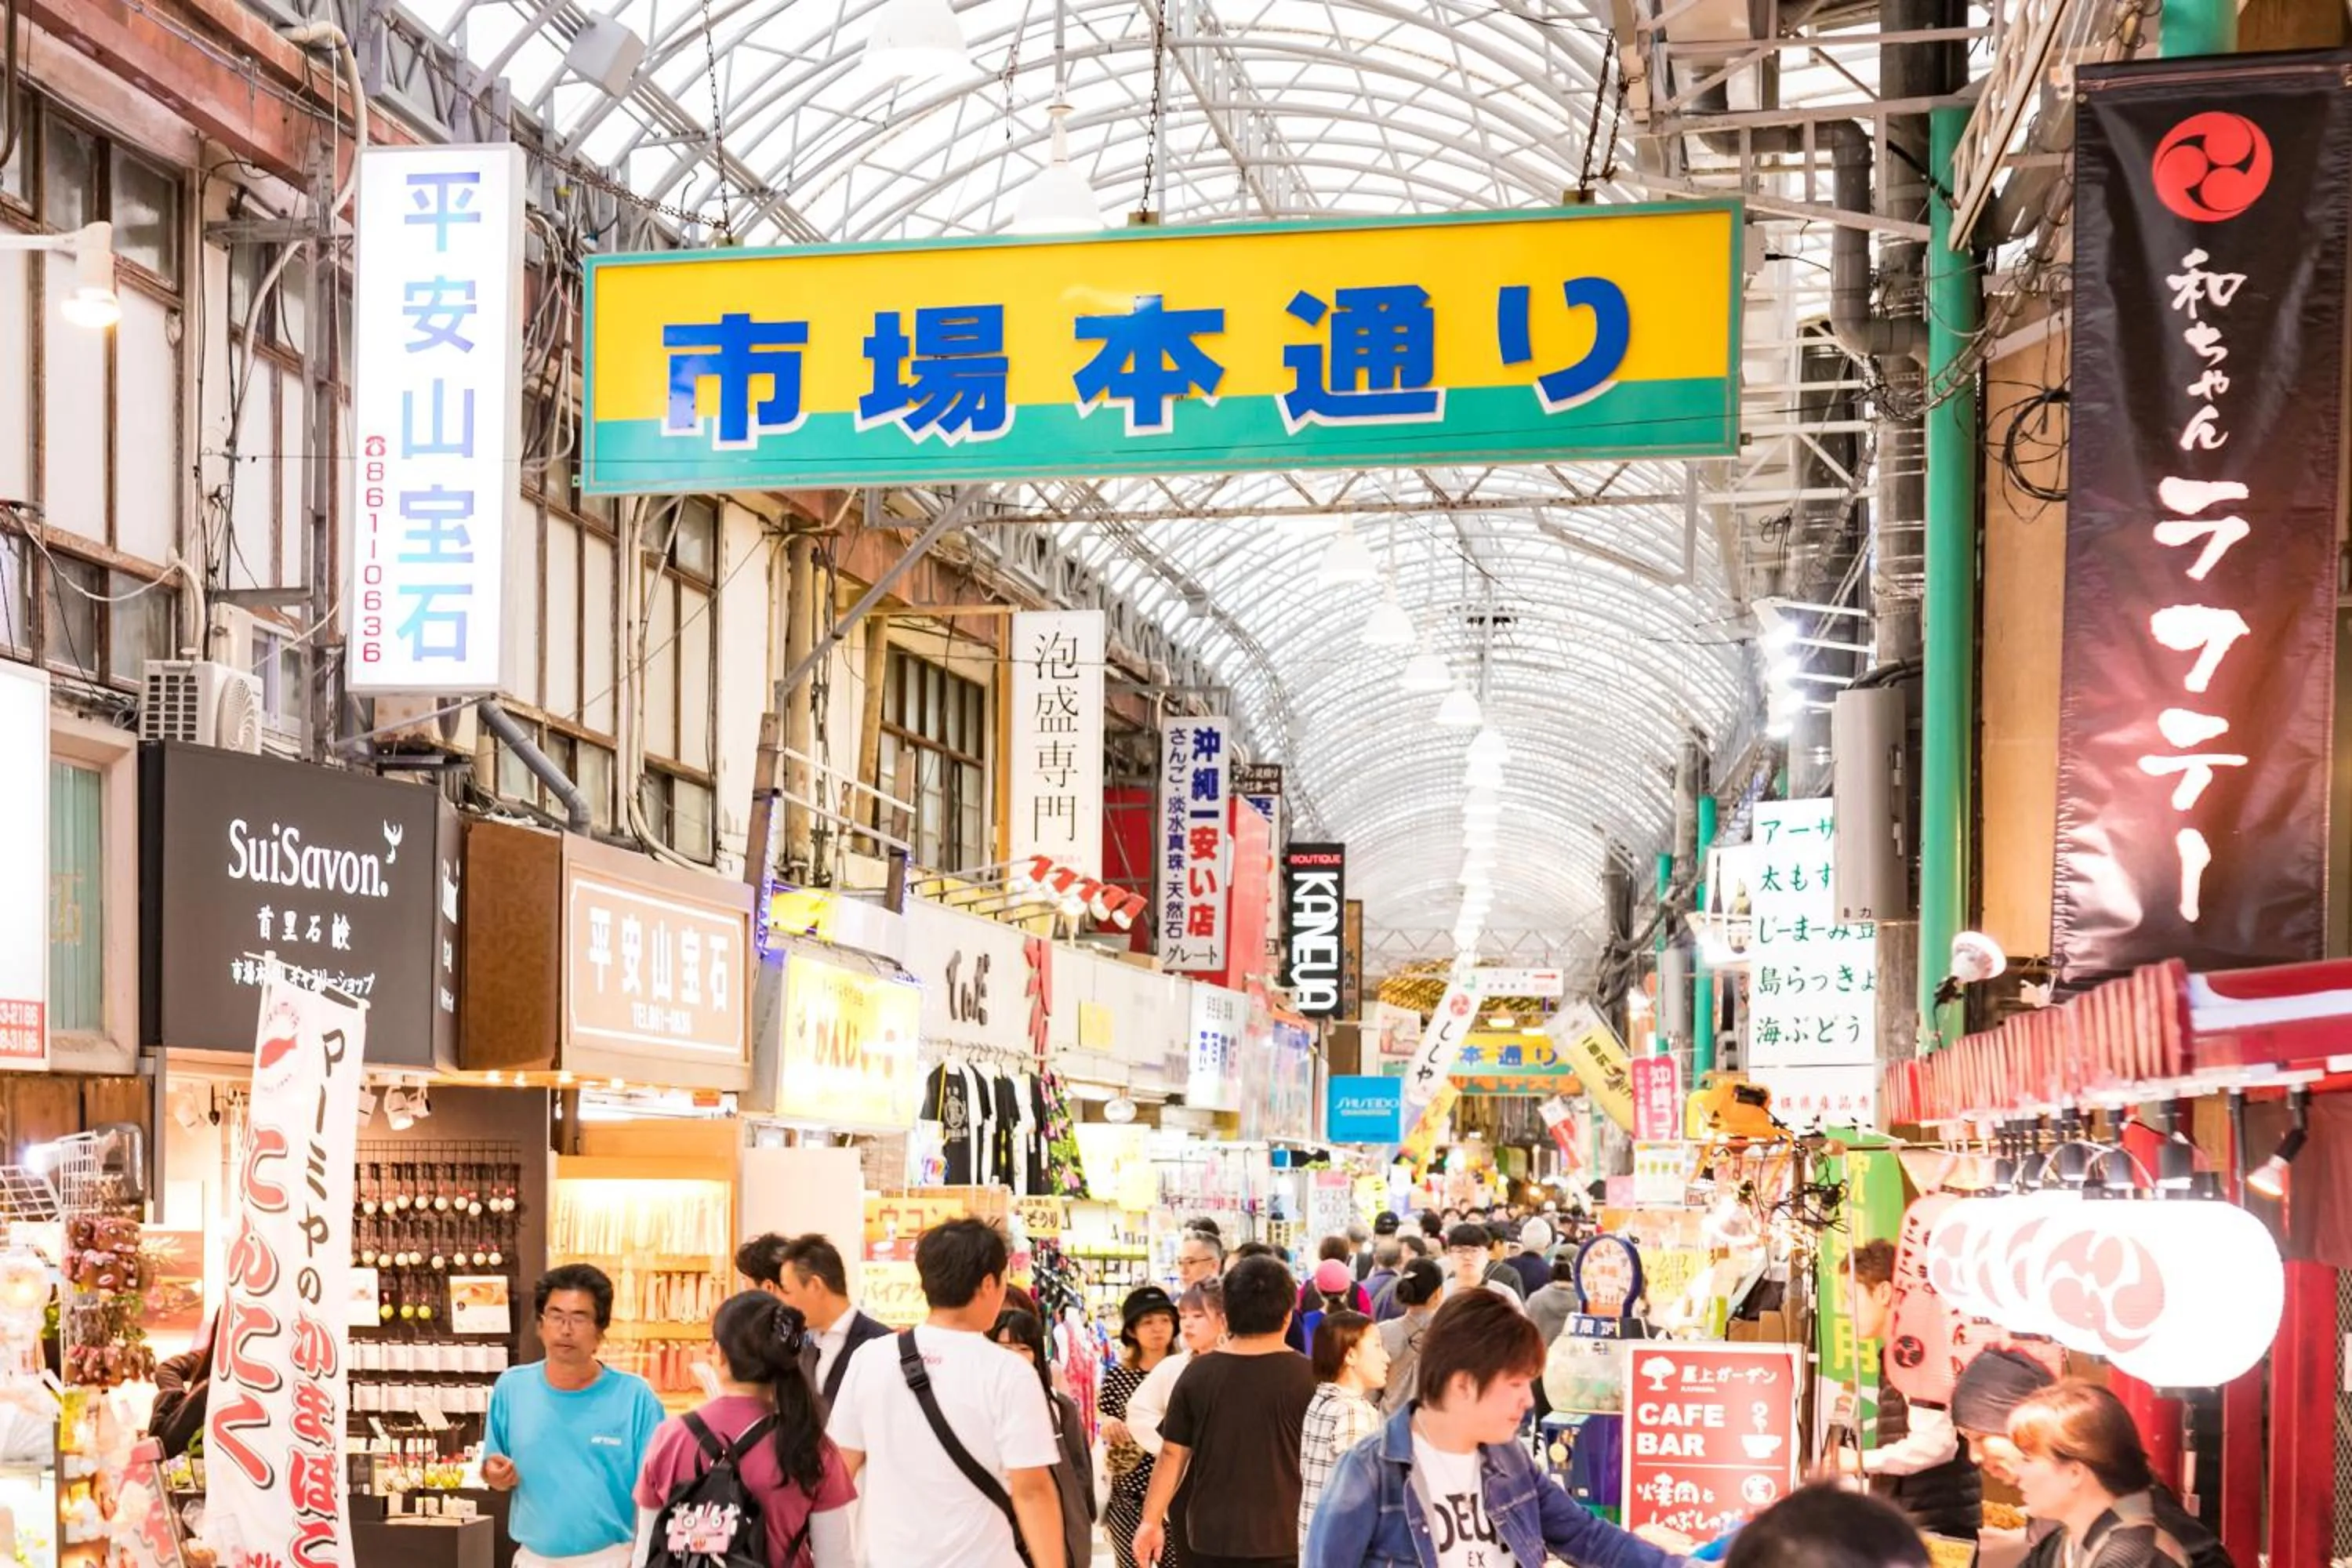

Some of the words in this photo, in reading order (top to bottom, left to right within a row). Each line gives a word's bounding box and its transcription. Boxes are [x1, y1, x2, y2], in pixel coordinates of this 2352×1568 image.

[661, 275, 1632, 450] 市場本通り
[397, 171, 481, 662] 平安山宝石
[1033, 630, 1080, 844] 泡盛専門
[1187, 727, 1221, 939] 沖縄一安い店
[1290, 853, 1342, 864] BOUTIQUE
[588, 906, 729, 1012] 平安山宝石
[1164, 943, 1219, 967] グレート
[1756, 1016, 1861, 1046] 海ぶどう
[1680, 1365, 1777, 1385] 屋上ガーデン
[1636, 1402, 1726, 1428] CAFE
[1635, 1432, 1705, 1457] BAR
[1433, 1493, 1511, 1554] DEU
